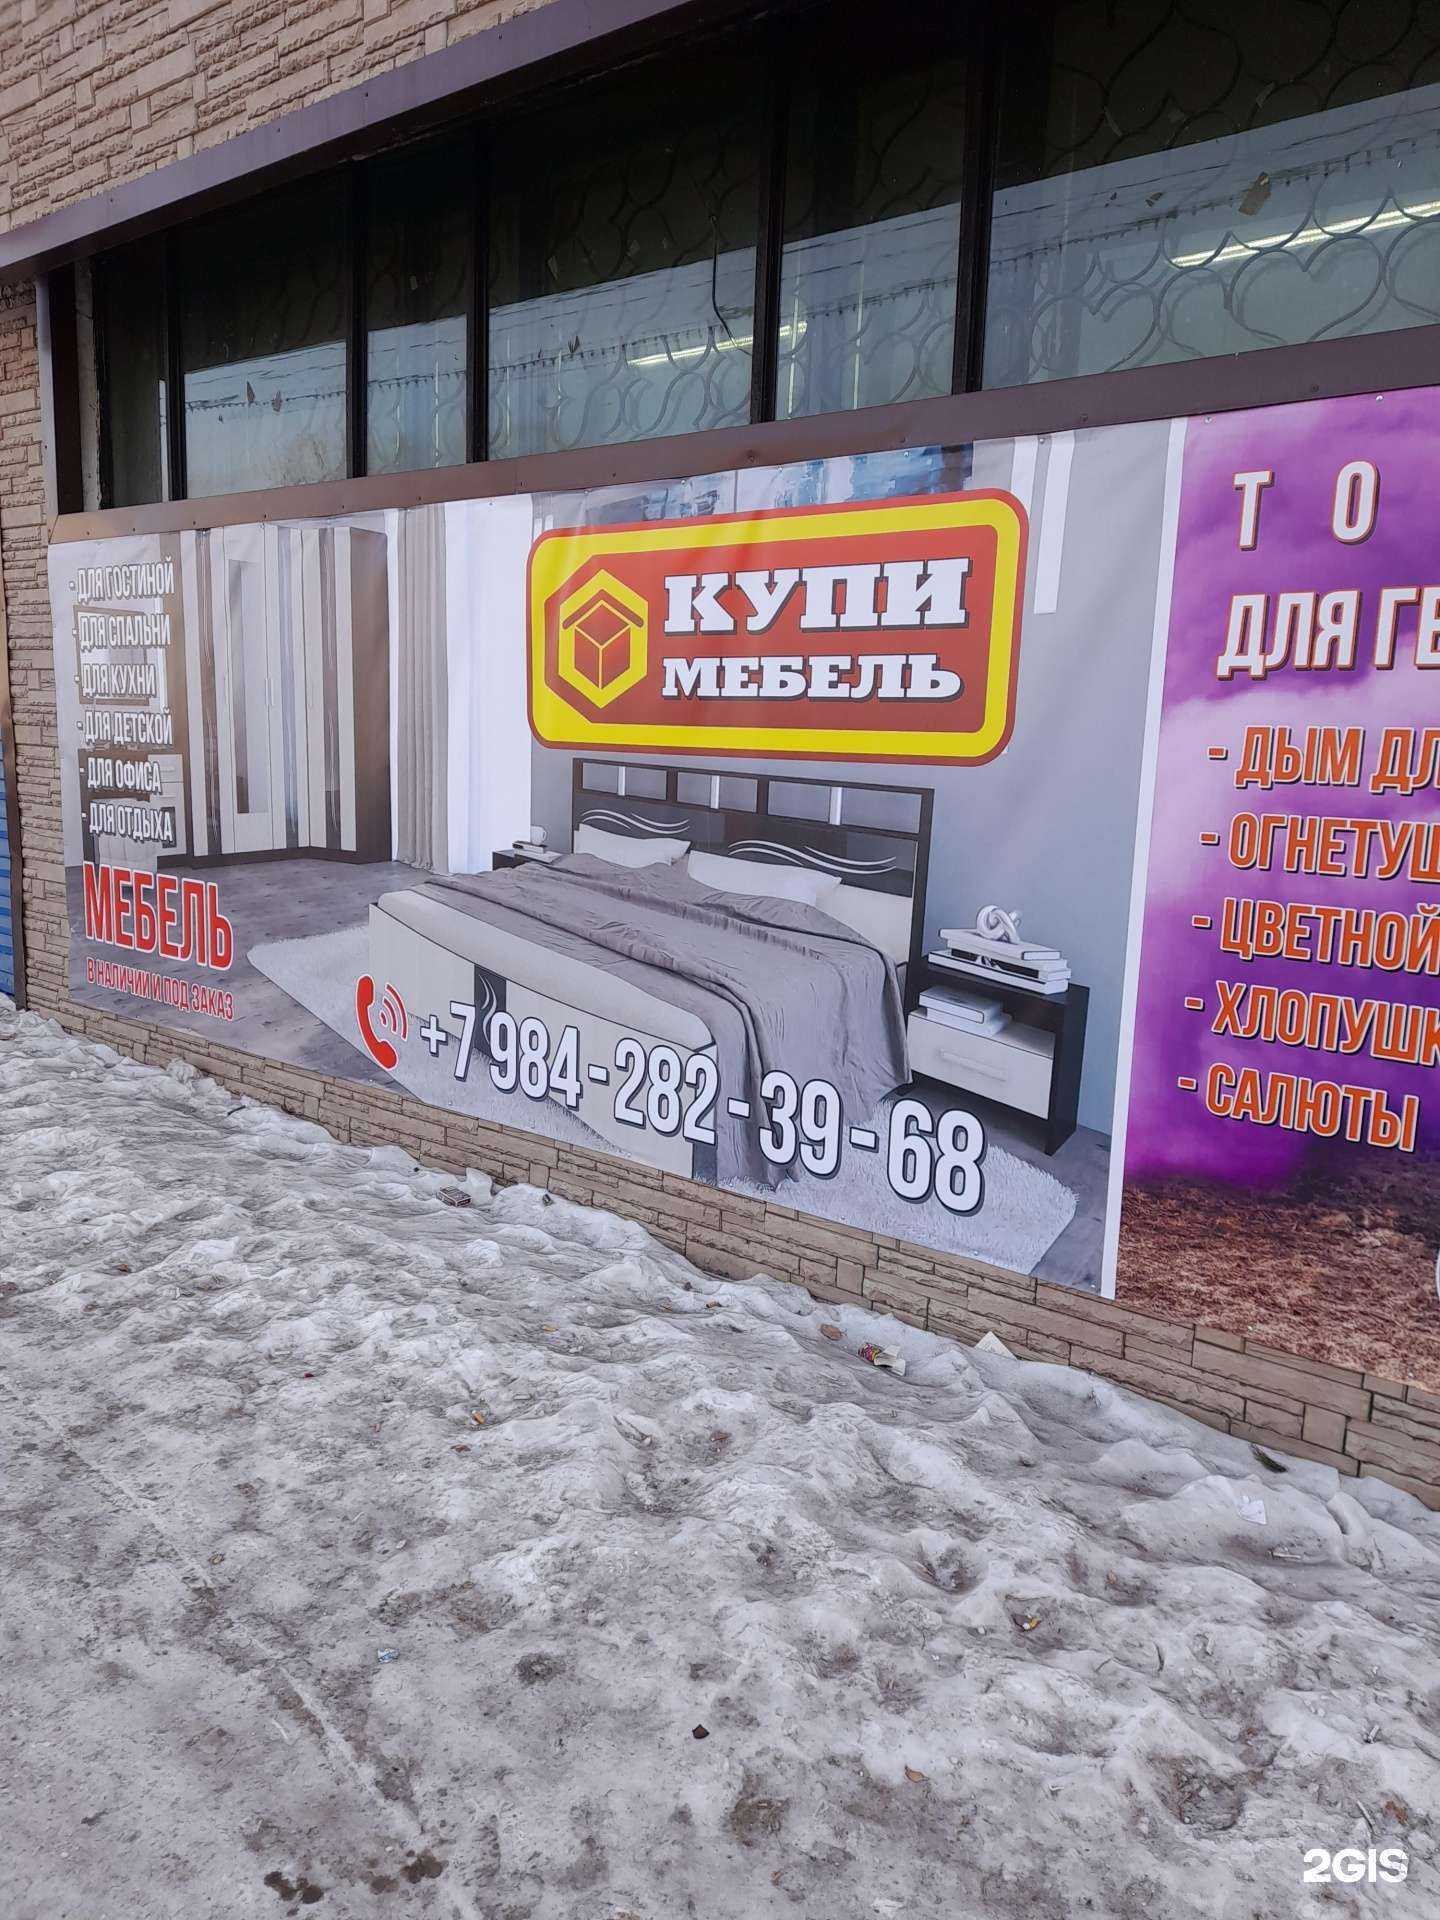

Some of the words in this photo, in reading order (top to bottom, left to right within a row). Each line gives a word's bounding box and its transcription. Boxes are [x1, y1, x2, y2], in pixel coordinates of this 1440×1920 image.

[78, 567, 105, 603] ДЛЯ
[105, 556, 175, 600] ГОСТИНОЙ
[663, 556, 972, 636] КУПИ
[80, 616, 106, 651] ДЛЯ
[108, 614, 171, 649] СПАЛЬНИ
[1215, 589, 1363, 681] ДЛЯ
[82, 663, 108, 698] ДЛЯ
[111, 663, 157, 698] КУХНИ
[661, 653, 967, 702] МЕБЕЛЬ
[85, 710, 111, 744] ДЛЯ
[113, 707, 173, 746] ДЕТСКОЙ
[1234, 726, 1365, 790] ДЫМ
[87, 757, 113, 790] ДЛЯ
[115, 759, 162, 795] ОФИСА
[89, 802, 116, 836] ДЛЯ
[117, 804, 174, 843] ОТДЫХА
[1228, 811, 1440, 884] ОГНЕТУШ
[83, 861, 233, 971] МЕБЕЛЬ
[1220, 897, 1440, 975] ЦВЕТНОЙ
[86, 956, 97, 984] В
[97, 961, 150, 1000] НАЛИЧИИ
[151, 972, 161, 1003] И
[163, 975, 190, 1013] ПОД
[191, 983, 234, 1021] ЗАКАЗ
[420, 1001, 476, 1082] +7
[1206, 1062, 1421, 1154] САЛЮТЫ
